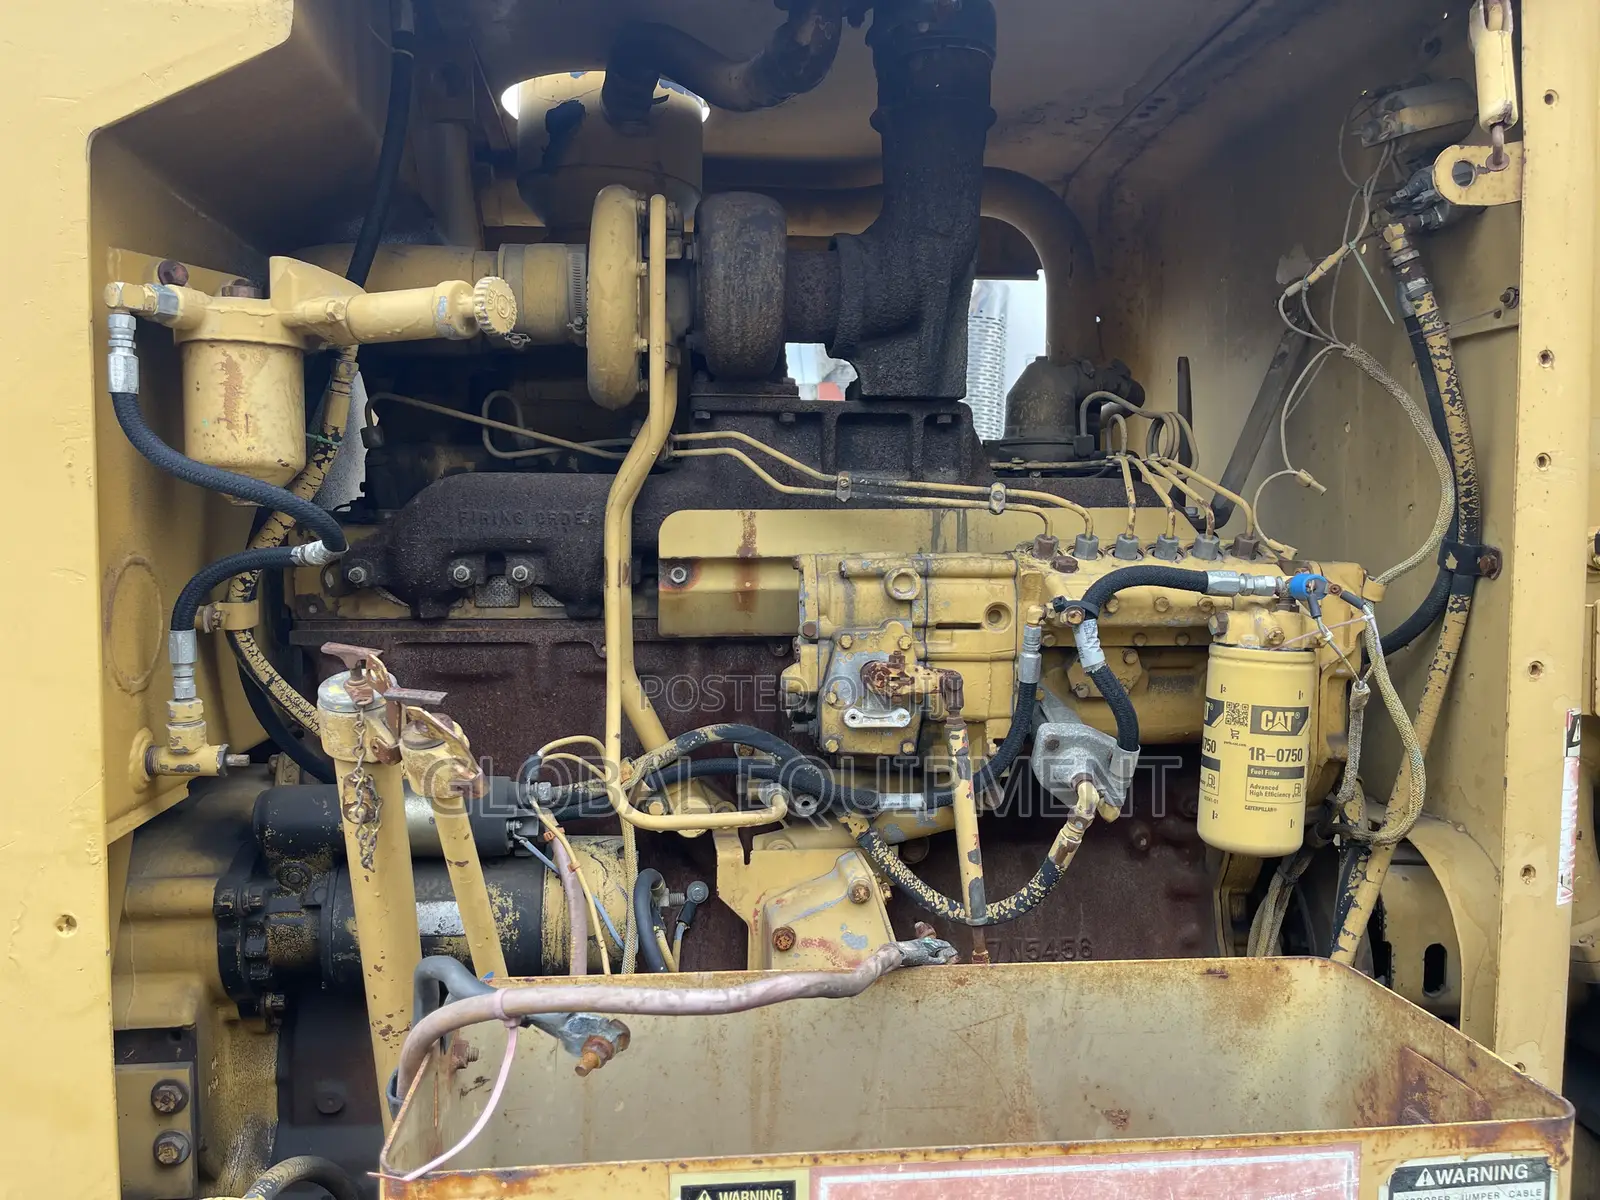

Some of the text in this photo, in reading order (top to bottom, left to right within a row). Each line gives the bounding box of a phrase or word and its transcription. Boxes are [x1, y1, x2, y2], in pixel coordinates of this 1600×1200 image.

[457, 509, 524, 526] FIRING
[1260, 710, 1294, 732] CAT
[1248, 747, 1303, 762] 1R-0750
[1250, 768, 1281, 777] Fuel Filter
[1249, 783, 1280, 791] Advanced
[1249, 789, 1292, 798] High Efficiency
[1435, 1164, 1528, 1185] WARNING
[1508, 1188, 1542, 1198] CABLE
